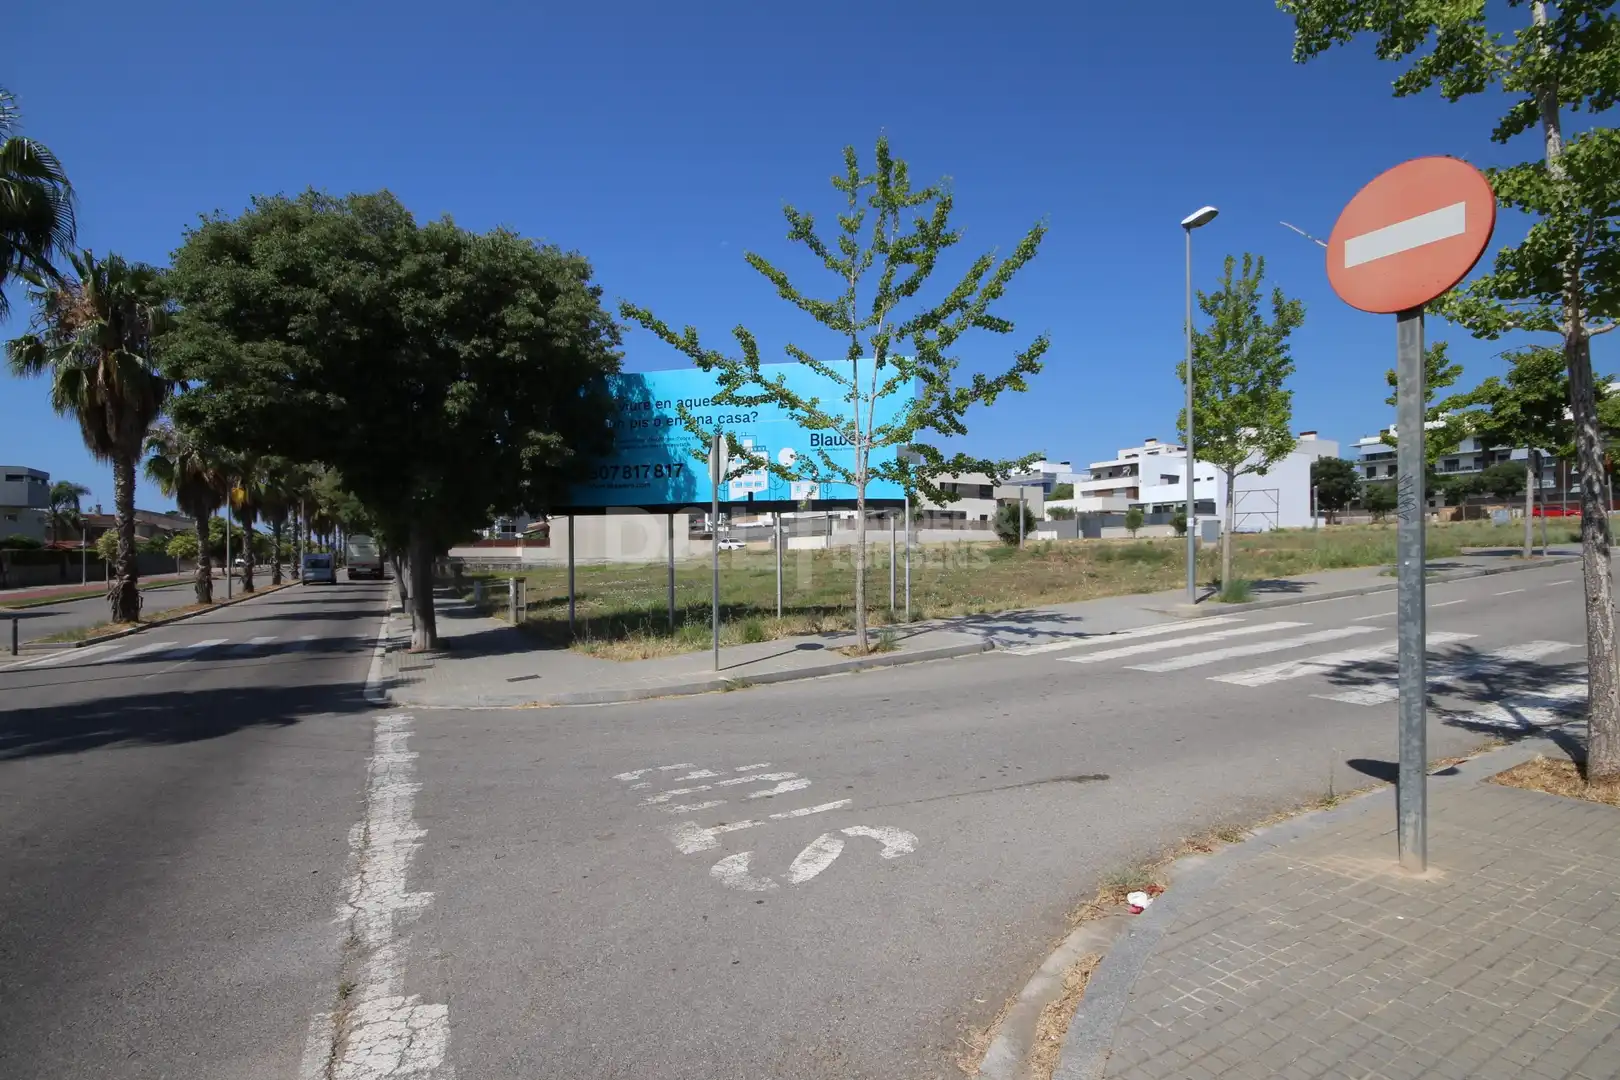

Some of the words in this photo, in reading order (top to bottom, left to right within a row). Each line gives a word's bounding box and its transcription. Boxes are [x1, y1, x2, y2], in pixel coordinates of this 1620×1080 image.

[655, 399, 672, 409] en
[653, 417, 662, 427] o
[667, 416, 682, 426] en
[717, 411, 759, 424] casa?
